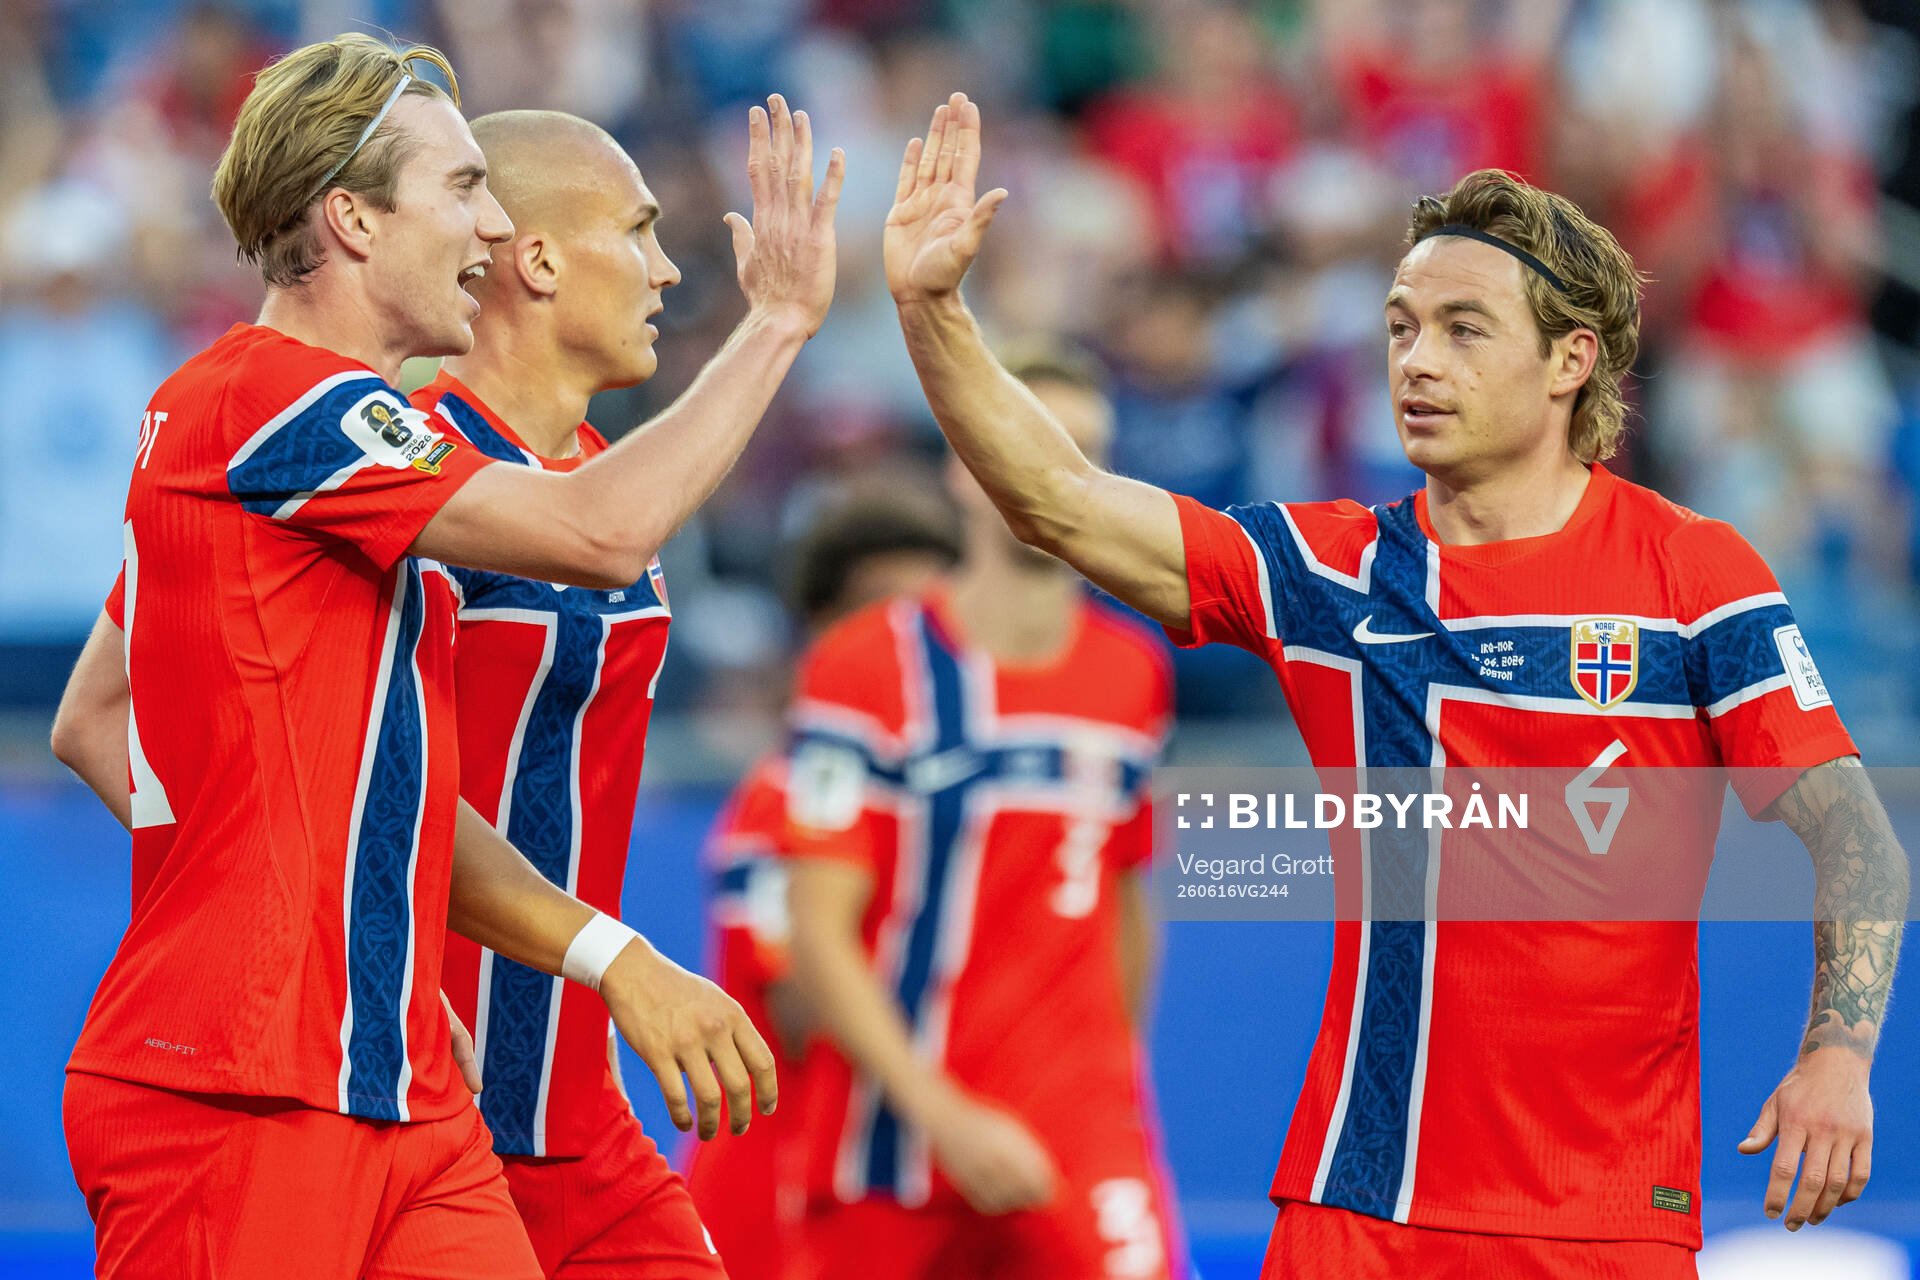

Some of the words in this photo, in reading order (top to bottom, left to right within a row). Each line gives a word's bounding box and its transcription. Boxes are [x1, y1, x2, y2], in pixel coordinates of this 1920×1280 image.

[405, 434, 432, 461] 2026
[1594, 622, 1616, 631] NORGE
[1480, 665, 1513, 681] BOSTON
[1565, 738, 1629, 855] 6
[144, 1037, 198, 1056] AERO-FIT
